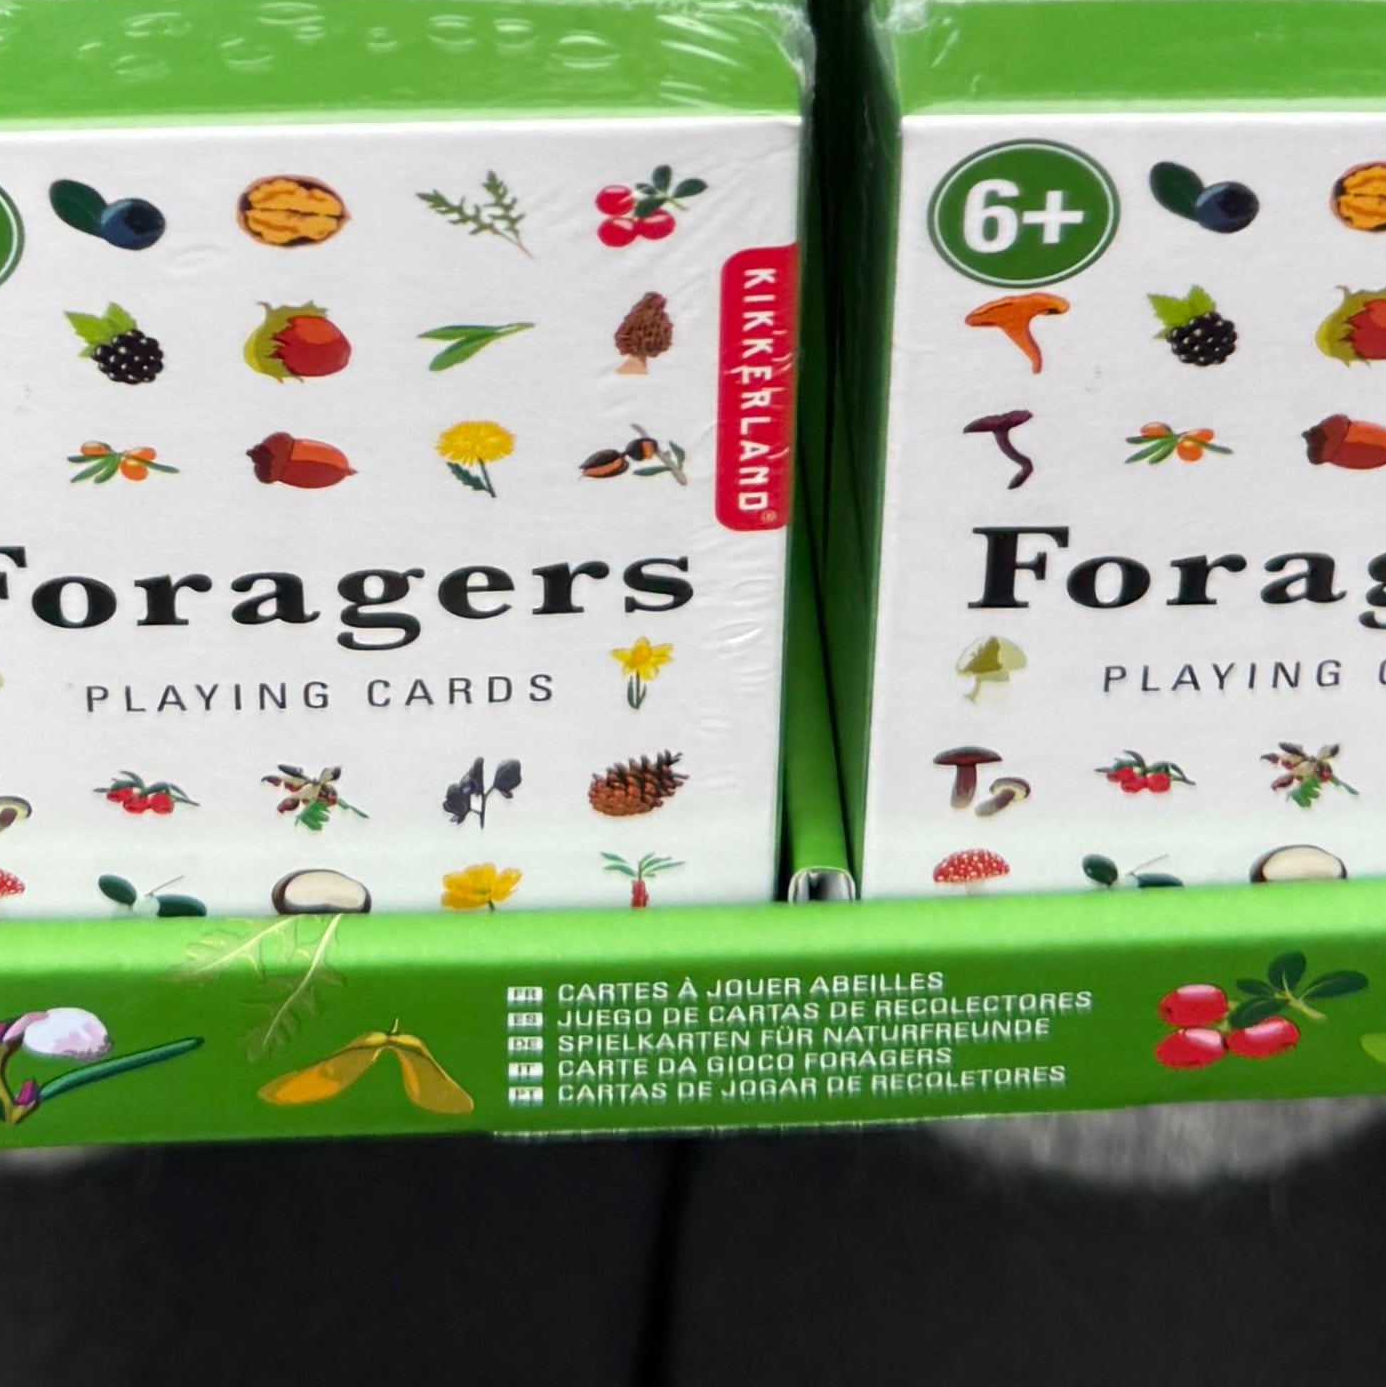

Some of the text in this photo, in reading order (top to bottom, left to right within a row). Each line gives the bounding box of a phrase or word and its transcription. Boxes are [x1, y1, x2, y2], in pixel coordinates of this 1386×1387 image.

[963, 178, 1085, 254] 6+
[738, 268, 776, 511] KIKKERLAND
[87, 674, 552, 712] PLAYING CARDS
[1104, 660, 1341, 692] PLAYING
[558, 982, 668, 1003] CARTES
[678, 977, 698, 1001] À
[707, 978, 800, 999] JOUER
[810, 972, 943, 994] ABEILLES
[558, 1008, 652, 1028] JUEGO
[663, 1007, 698, 1025] DE
[709, 1003, 819, 1023] CARTAS
[830, 1001, 864, 1020] DE
[875, 991, 1092, 1018] RECOLECTORES
[559, 1031, 749, 1054] SPIELKARTEN
[761, 1026, 813, 1048] FÜR
[823, 1018, 1050, 1044] NATURFREUNDE
[559, 1059, 648, 1078] CARTE
[658, 1057, 697, 1075] DA
[707, 1054, 793, 1075] GIOCO
[805, 1047, 951, 1072] FORAGERS
[558, 1083, 666, 1103] CARTAS
[678, 1081, 711, 1100] DE
[722, 1078, 816, 1099] JOGAR
[827, 1076, 861, 1096] DE
[872, 1065, 1065, 1091] RECOLETORES
